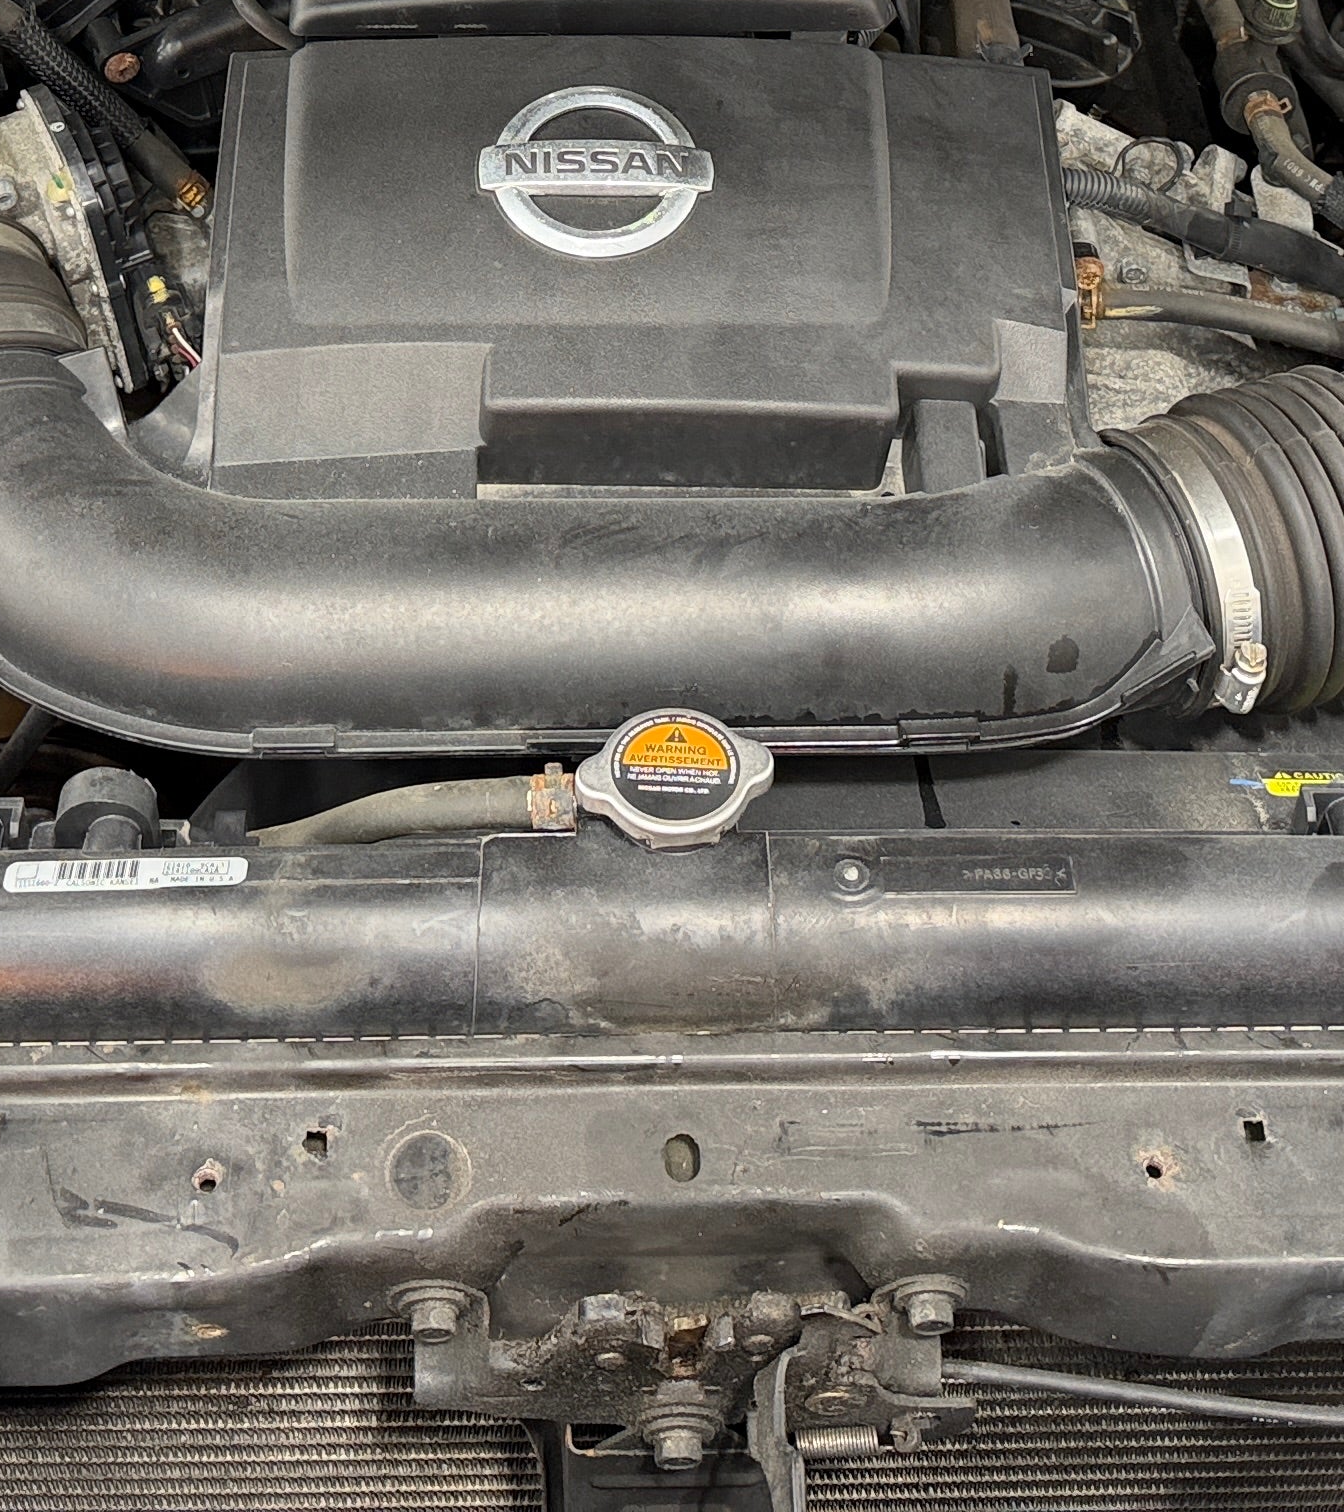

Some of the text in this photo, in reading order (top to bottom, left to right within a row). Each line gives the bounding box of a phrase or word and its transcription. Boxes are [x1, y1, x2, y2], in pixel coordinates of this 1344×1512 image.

[506, 148, 688, 177] NISSAN
[645, 744, 707, 755] WARNING
[629, 754, 723, 766] AVERTISSEMENT
[678, 768, 702, 776] WHEN
